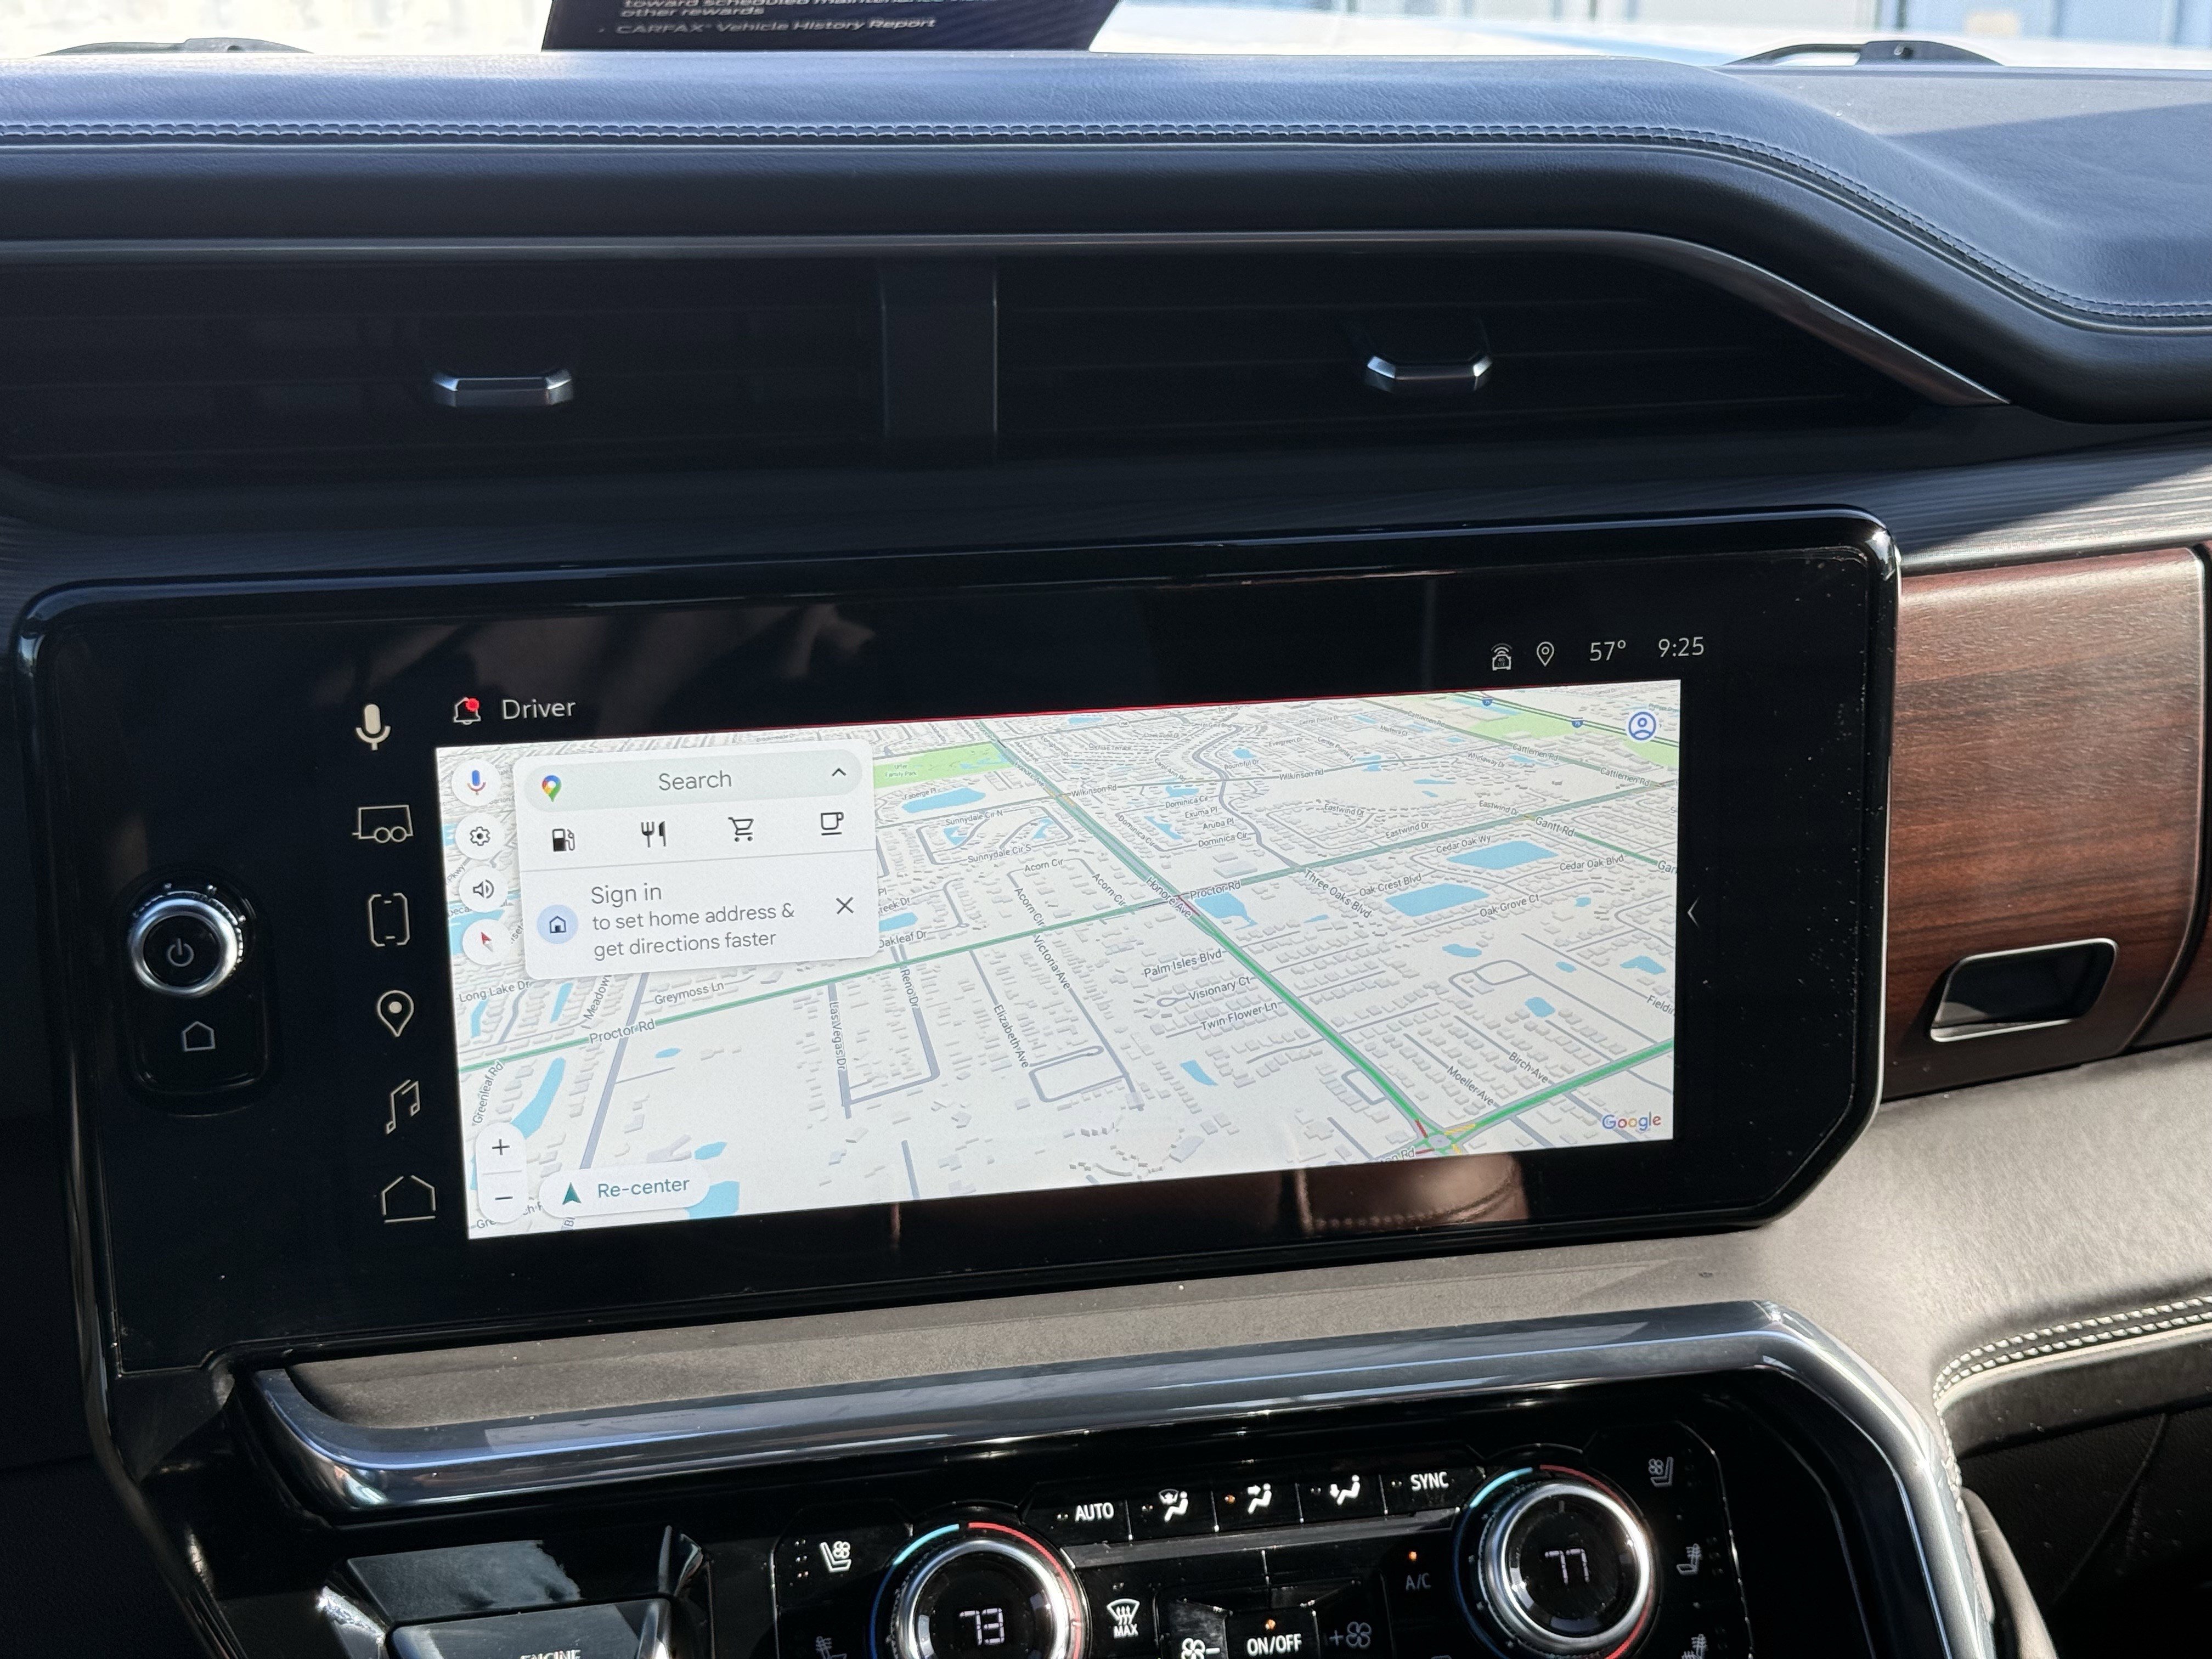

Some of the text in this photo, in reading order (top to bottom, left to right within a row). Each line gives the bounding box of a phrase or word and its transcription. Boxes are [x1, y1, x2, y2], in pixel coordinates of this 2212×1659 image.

[620, 6, 765, 17] other rewards
[715, 21, 789, 32] Vehicle
[793, 19, 866, 30] History
[868, 18, 936, 29] Report
[1590, 640, 1627, 661] 57°
[1658, 636, 1705, 658] 9:25
[502, 698, 576, 720] Driver
[1513, 743, 1559, 761] Cattlemen Rd
[658, 771, 733, 792] Search
[1600, 766, 1650, 787] Cattlemen Rd
[1165, 797, 1199, 809] Dominica
[1184, 808, 1210, 819] Exuma
[1324, 804, 1365, 817] Eastwind Dr
[1479, 800, 1519, 816] Eastwind Dr
[945, 812, 983, 826] Sunnydale
[1118, 815, 1149, 840] Dominica
[1203, 817, 1235, 830] Aruba Pl
[1198, 833, 1236, 848] Dominica
[1385, 821, 1430, 839] Eastwind Dr
[1560, 824, 1576, 837] Rd
[967, 844, 1032, 864] Sunnydale Cir S
[1436, 834, 1491, 854] Cedar Oak Wy
[1024, 860, 1051, 873] Acorn
[1559, 854, 1624, 872] Cedar Oak Blvd
[1092, 873, 1115, 898] Acorn
[1190, 880, 1242, 900] Proctor Rd
[1304, 869, 1372, 919] Three Oaks Blvd
[1359, 873, 1423, 896] Oak Crest Blvd
[591, 883, 663, 908] Sign in
[878, 897, 910, 915] reek Dr
[1014, 887, 1035, 915] Acorn
[1146, 876, 1192, 918] Honore Ave
[1480, 894, 1540, 917] Oak Grove Ct
[592, 902, 795, 930] to set home address &
[916, 930, 927, 940] Dr
[594, 930, 777, 962] get directions faster
[1032, 934, 1071, 990] Victoria Ave
[1143, 948, 1222, 978] Palm Isles Blvd
[458, 979, 531, 1004] Long Lake Dr
[654, 981, 725, 1006] Greymoss Ln
[901, 968, 919, 1008] Reno Dr
[1188, 975, 1251, 1001] Visionary Ct
[1200, 1001, 1278, 1030] Twin Flower Ln
[589, 1018, 656, 1045] Proctor Rd
[830, 1001, 846, 1070] Las Vegas Dr
[994, 1003, 1029, 1069] Elizabeth Ave
[1509, 1052, 1549, 1084] Birch Ave
[471, 1060, 505, 1126] Greenleaf Rd
[1447, 1065, 1494, 1106] Moeller Ave
[1601, 1110, 1662, 1131] Google
[1401, 1147, 1415, 1160] Rd
[597, 1177, 690, 1198] Re-center
[1410, 1471, 1449, 1492] SYNC
[1075, 1502, 1114, 1522] AUTO
[1544, 1547, 1590, 1585] 77
[1405, 1573, 1432, 1592] A/C
[1113, 1623, 1138, 1638] MAX
[1246, 1633, 1302, 1657] ON/OFF
